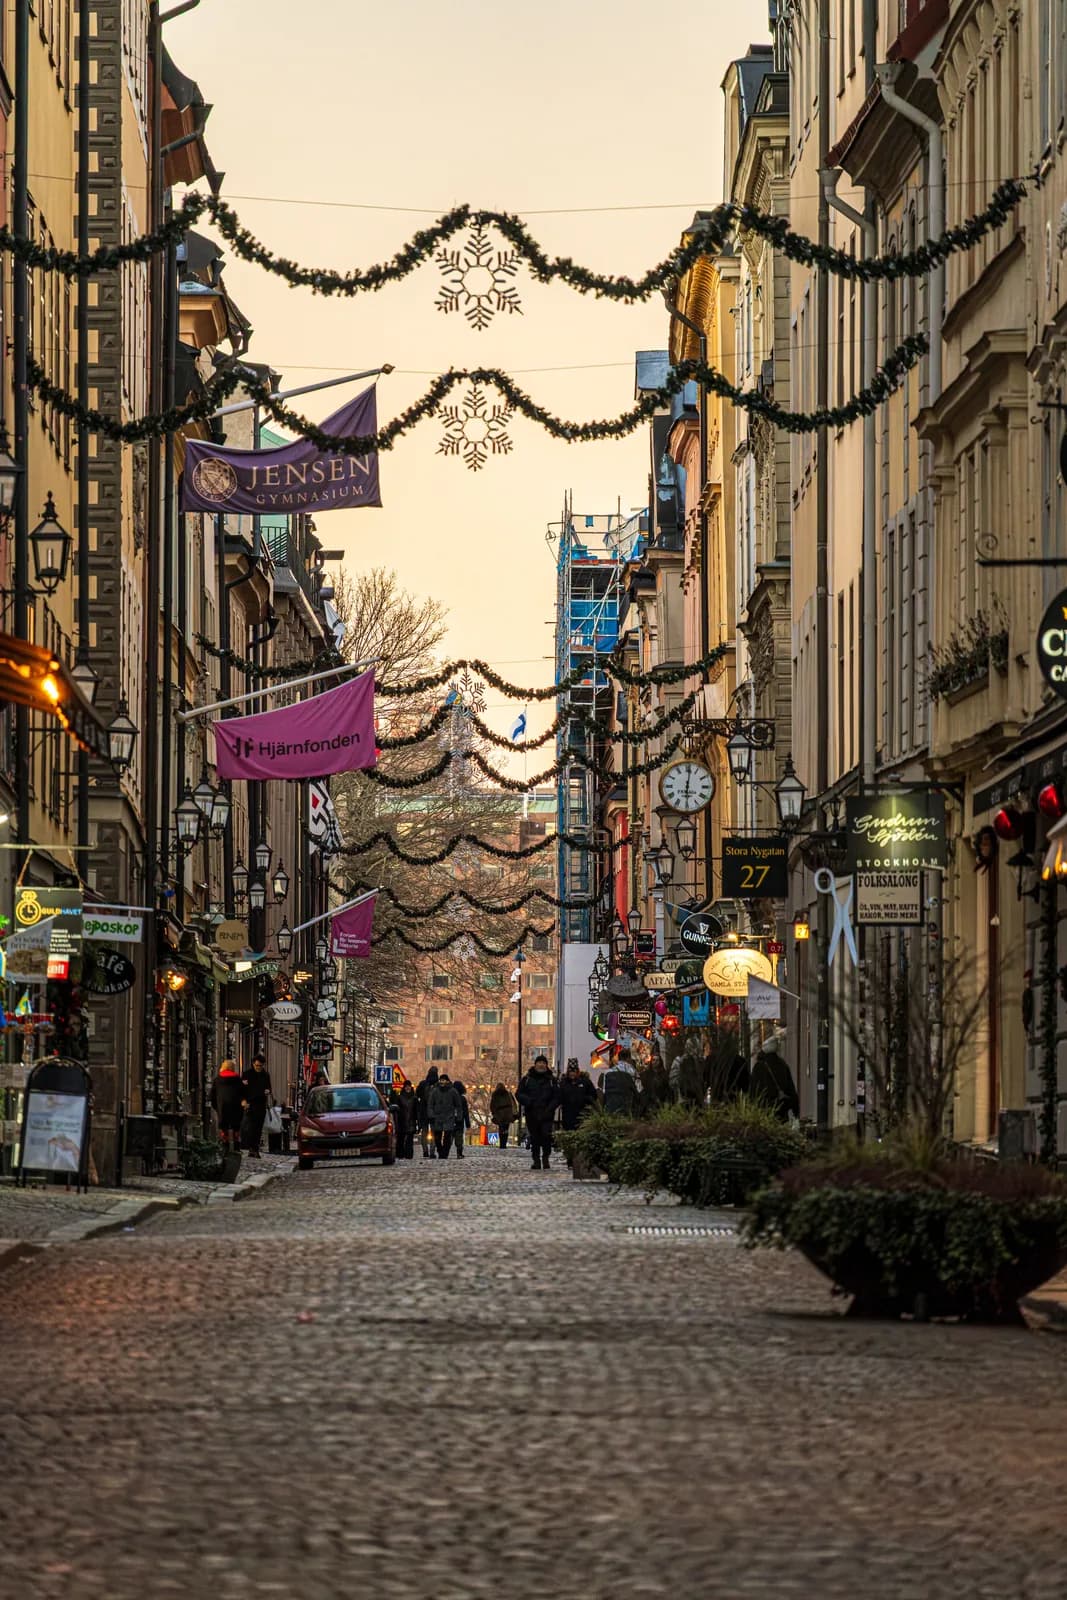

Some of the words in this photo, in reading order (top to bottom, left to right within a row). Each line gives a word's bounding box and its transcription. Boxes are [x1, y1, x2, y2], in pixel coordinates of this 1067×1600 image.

[246, 455, 370, 490] JENSEN
[256, 485, 364, 505] GYMNASIUM
[1042, 628, 1067, 657] C
[259, 733, 361, 760] Hjärnfonden
[725, 846, 749, 856] Stora
[750, 846, 785, 859] Nygatan
[856, 858, 938, 868] STOCKHOLM
[740, 865, 770, 889] 27
[859, 875, 918, 888] FOLKSALONG
[96, 954, 126, 975] afé
